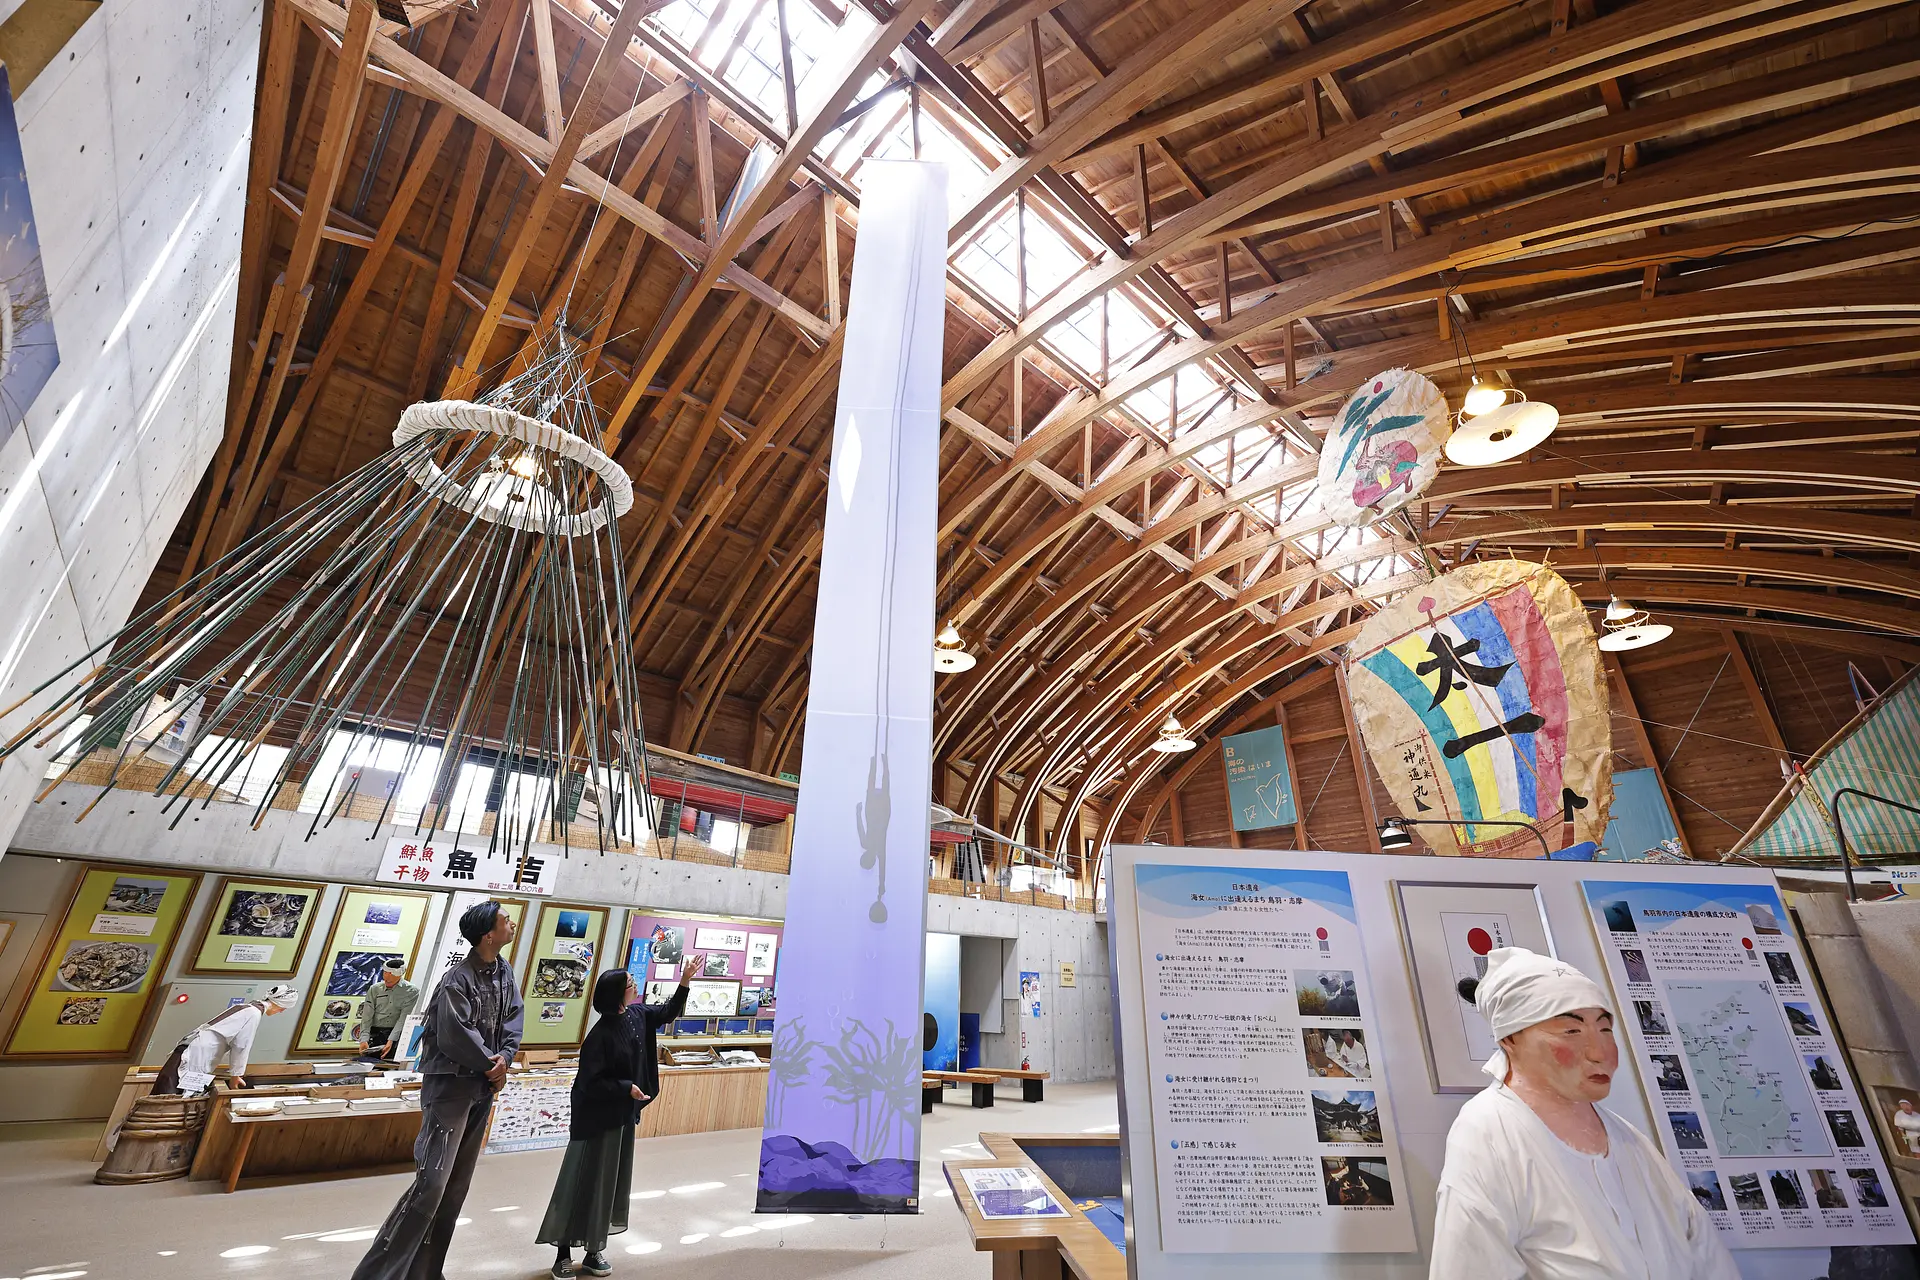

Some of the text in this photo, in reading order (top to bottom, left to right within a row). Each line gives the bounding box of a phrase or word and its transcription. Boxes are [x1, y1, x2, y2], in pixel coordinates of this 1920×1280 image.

[1225, 747, 1235, 757] B
[399, 844, 434, 863] 鮮魚
[393, 865, 430, 882] 干物
[1232, 884, 1259, 892] 日本遺産
[1643, 909, 1738, 919] 鳥羽市内の日本遺産の構成文化財
